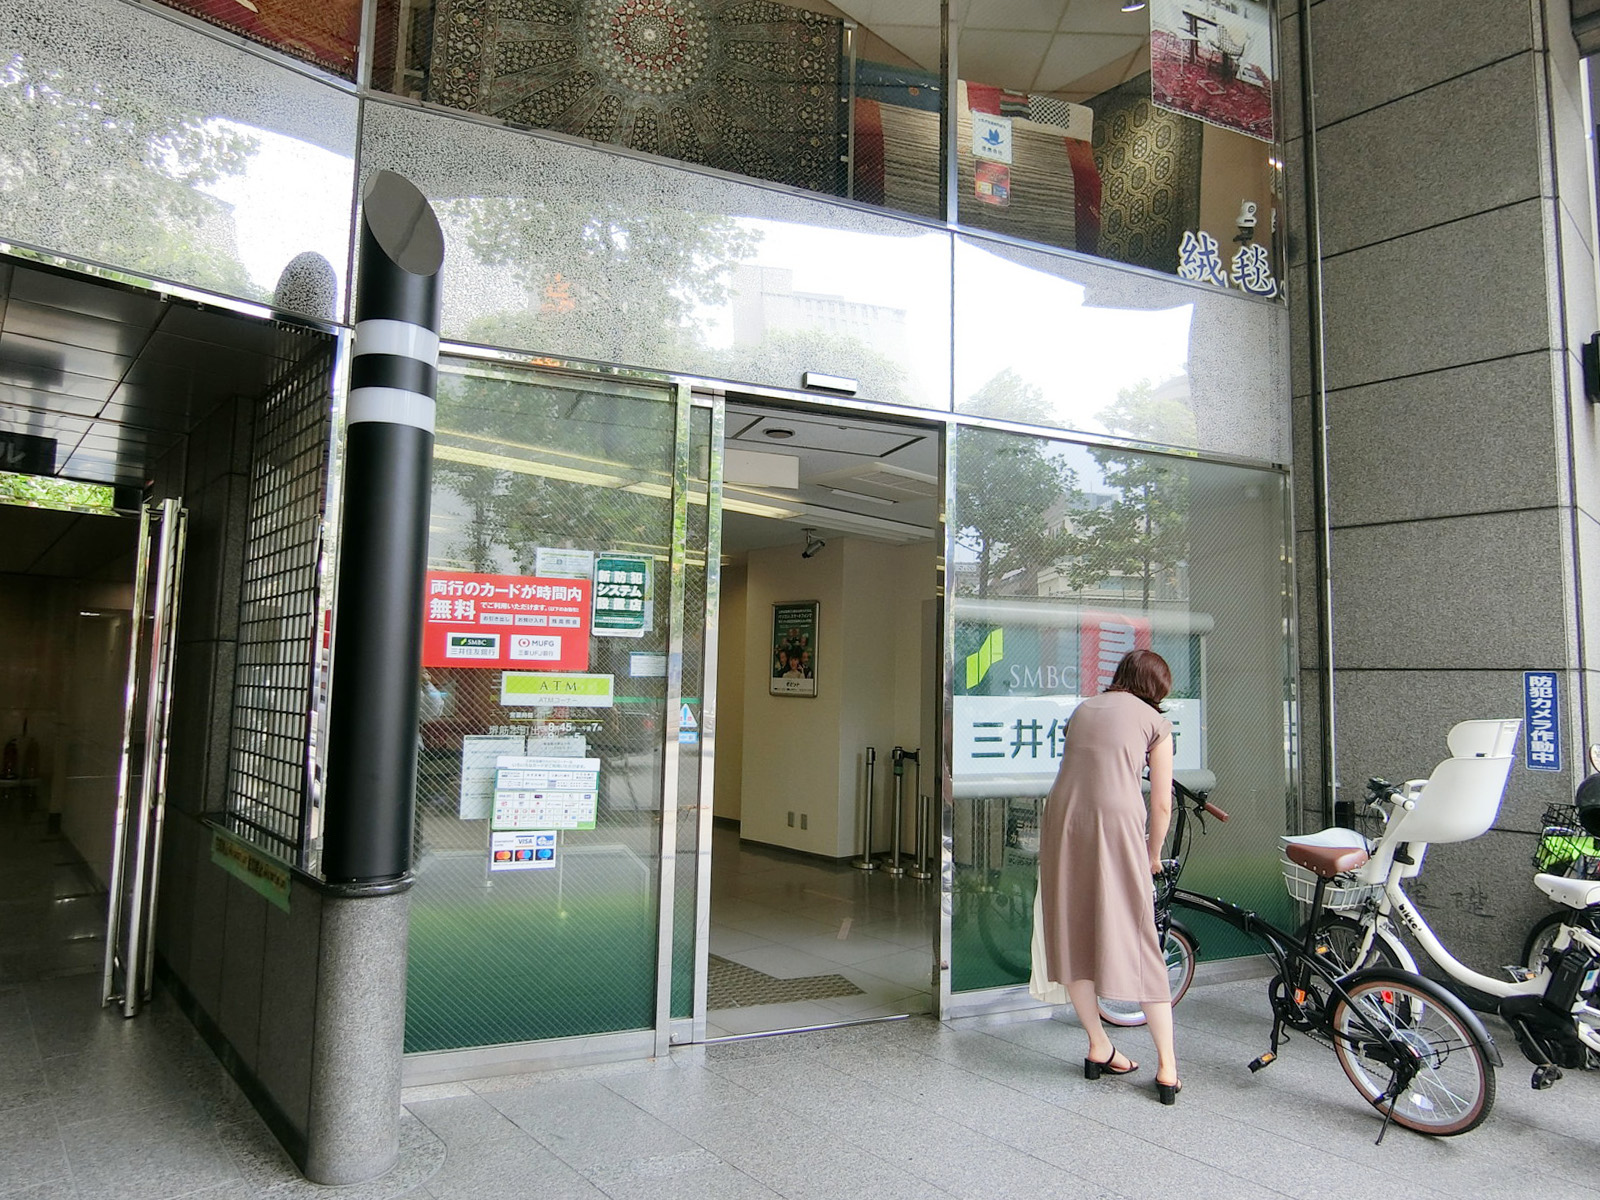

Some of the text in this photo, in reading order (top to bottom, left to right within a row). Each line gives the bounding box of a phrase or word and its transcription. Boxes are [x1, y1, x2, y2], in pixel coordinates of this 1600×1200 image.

[430, 579, 582, 602] 両行のカードが時間内
[597, 584, 643, 598] システム
[430, 598, 477, 620] 無料
[467, 638, 487, 646] SMBC
[540, 680, 577, 691] ATM
[1010, 664, 1077, 689] SMBC
[1529, 676, 1555, 763] 防犯カメラ作動中
